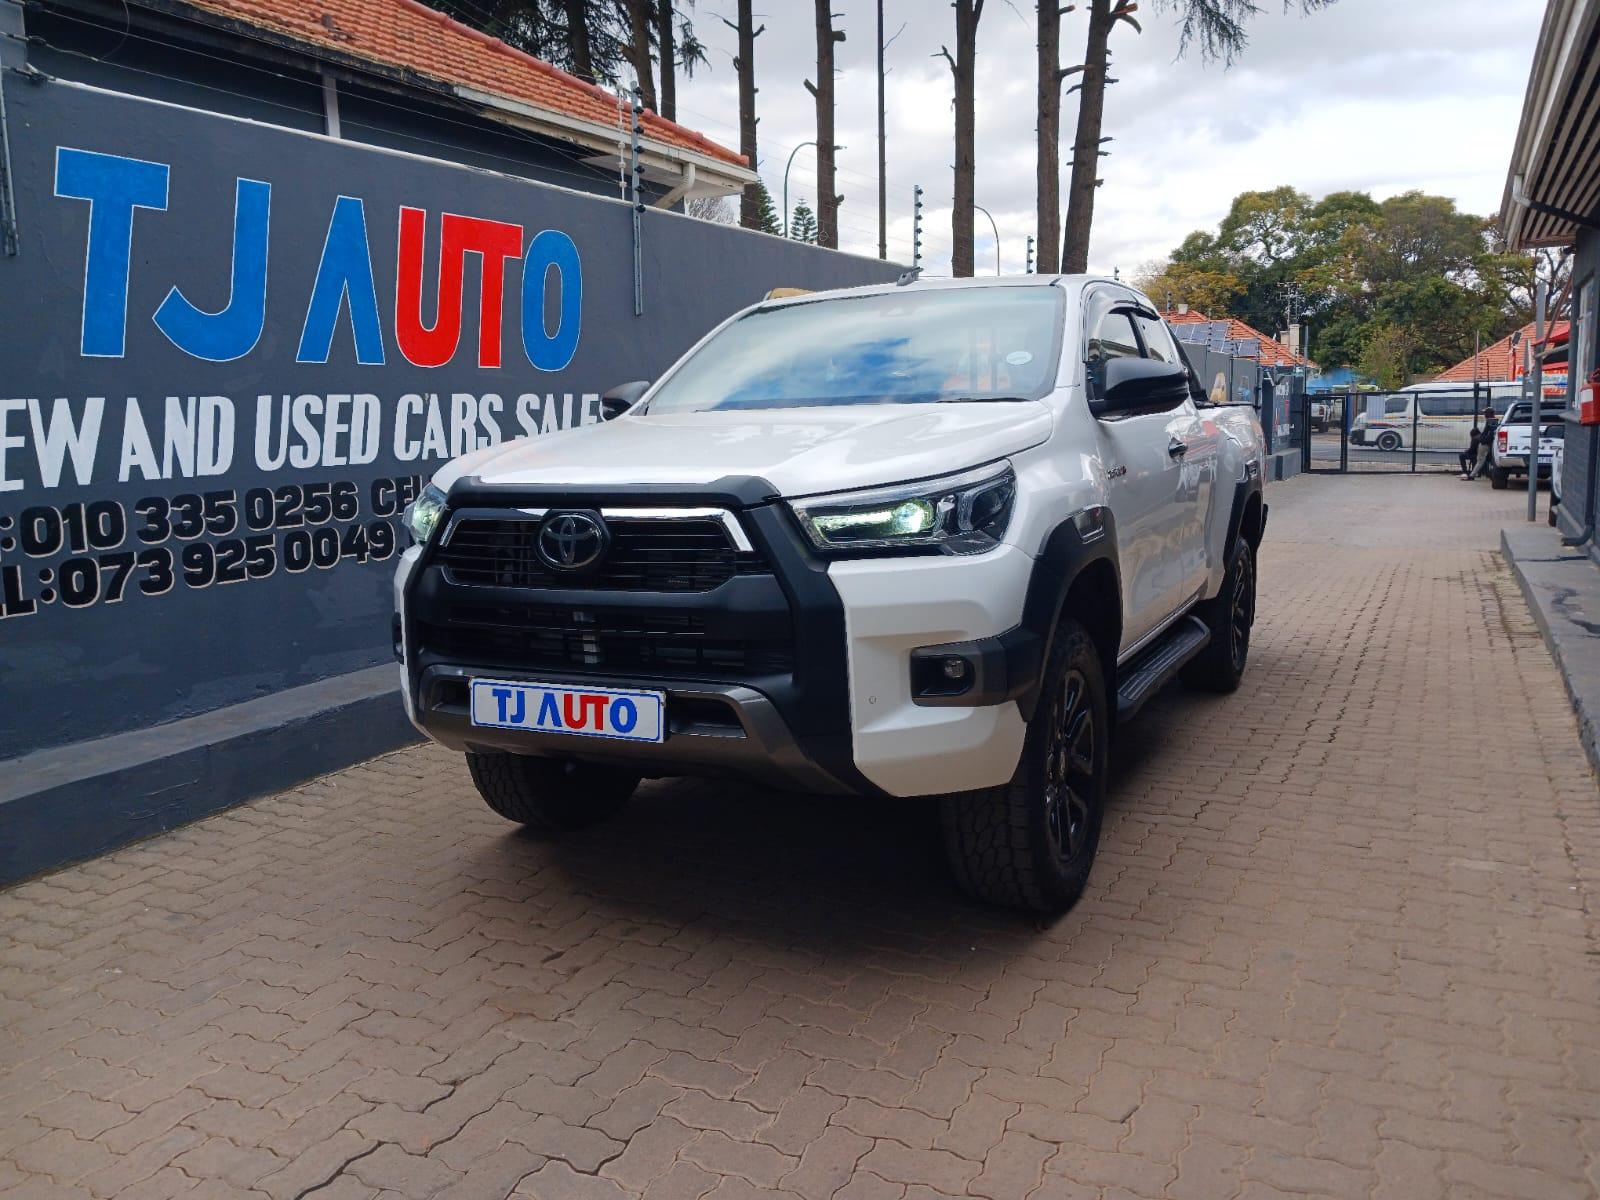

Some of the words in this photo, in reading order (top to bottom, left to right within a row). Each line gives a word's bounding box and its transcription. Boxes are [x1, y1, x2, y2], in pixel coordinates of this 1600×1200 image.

[54, 146, 272, 362] TJ
[296, 194, 583, 372] AUTO
[118, 395, 236, 482] AND
[254, 393, 382, 472] USED
[393, 392, 504, 461] CARS
[514, 393, 606, 440] SALE
[135, 489, 239, 544] 335
[245, 481, 360, 532] 0256
[0, 547, 176, 619] L:073
[182, 533, 278, 589] 925
[284, 521, 396, 574] 0049
[492, 688, 526, 724] TJ
[536, 692, 638, 734] AUTO
